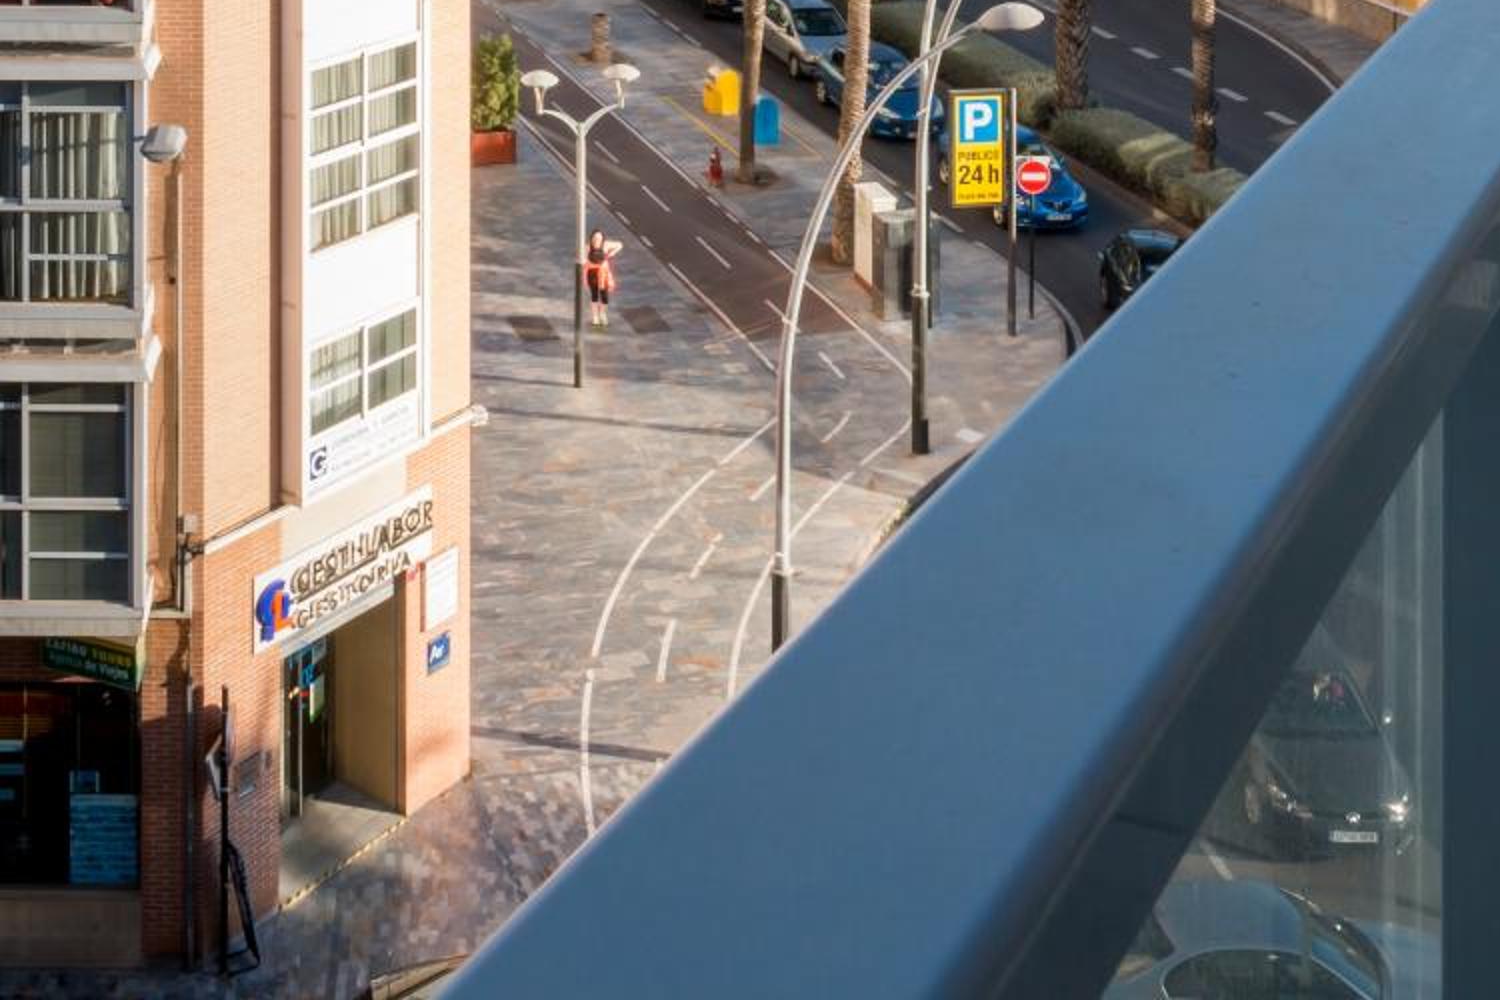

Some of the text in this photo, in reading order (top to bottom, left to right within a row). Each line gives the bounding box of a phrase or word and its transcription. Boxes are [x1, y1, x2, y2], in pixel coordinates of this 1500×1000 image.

[964, 101, 993, 141] P
[959, 163, 999, 185] 24 h
